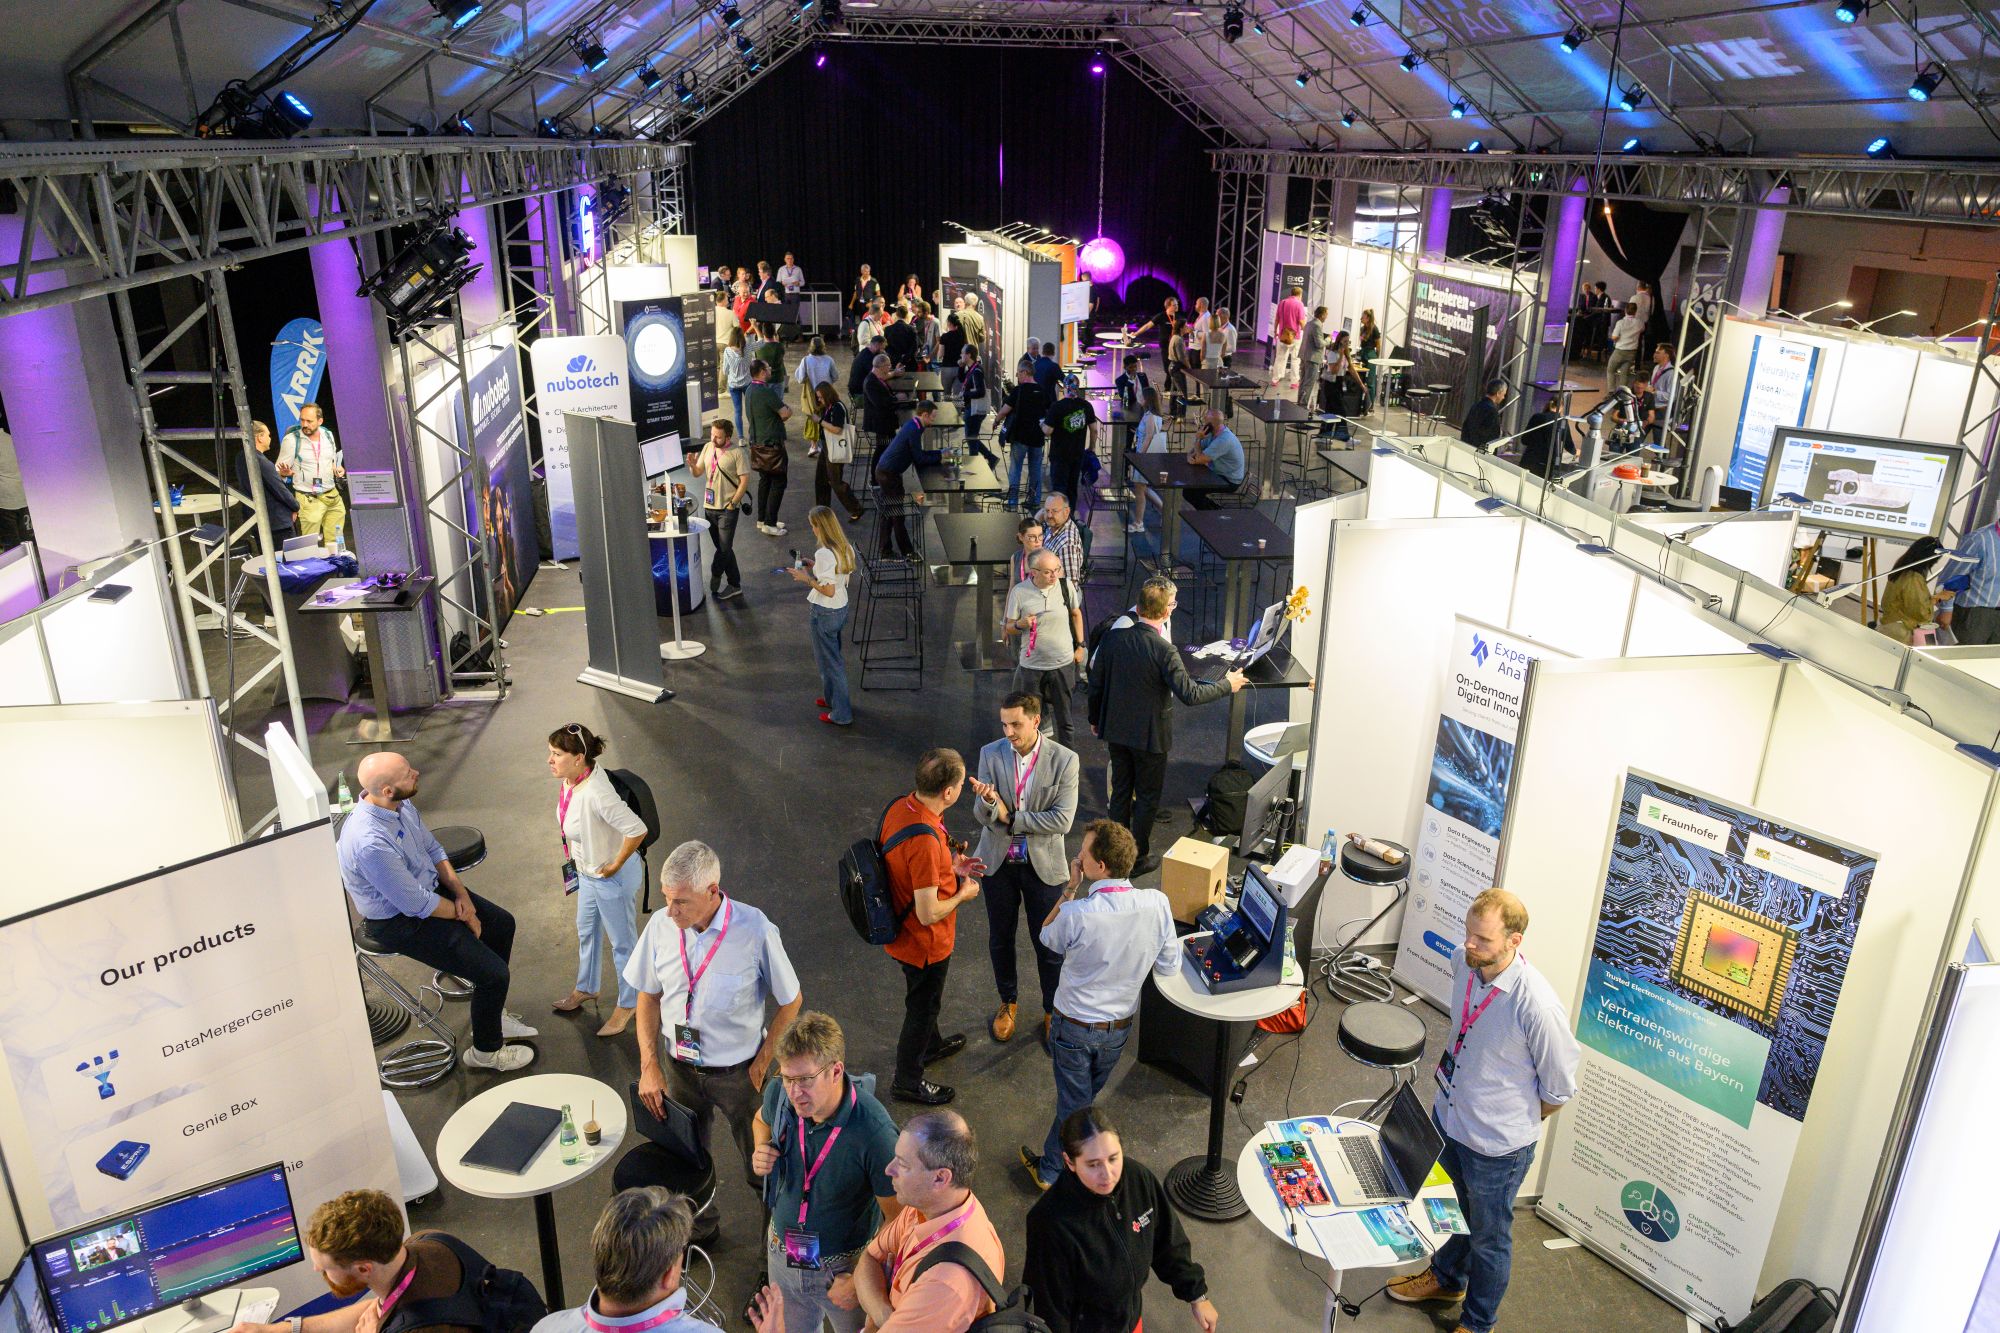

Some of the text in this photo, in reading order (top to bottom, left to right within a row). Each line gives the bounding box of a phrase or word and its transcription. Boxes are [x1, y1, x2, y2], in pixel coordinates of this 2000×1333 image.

[1428, 284, 1468, 310] kapieren
[1414, 304, 1437, 323] statt
[281, 330, 324, 421] ARRK
[547, 372, 619, 392] nubotech
[1759, 362, 1800, 382] Neuralyze
[482, 366, 510, 417] nubotech
[1756, 381, 1774, 394] Vision
[576, 403, 618, 412] Architecture
[1456, 673, 1519, 706] On-Demand
[1457, 686, 1490, 708] Digital
[1447, 826, 1460, 836] Data
[1461, 833, 1490, 853] Engineering
[1662, 814, 1718, 842] Fraunhofer
[1443, 851, 1456, 862] Data
[1456, 858, 1475, 873] Science
[1440, 878, 1460, 894] Systems
[1433, 903, 1456, 920] Software
[100, 922, 256, 986] Our products
[1406, 946, 1419, 959] From
[1419, 954, 1442, 973] Industrial
[1605, 970, 1718, 1028] Trusted Electronic Bayern Center
[162, 997, 294, 1058] DataMergerGenie
[1600, 996, 1731, 1068] Vertrauenswürdige
[1597, 1011, 1744, 1092] Elektronik aus Bayern
[182, 1098, 258, 1137] Genie Box
[120, 1144, 146, 1170] ESPRIT
[1564, 1208, 1593, 1229] Fraunhofer
[1627, 1248, 1657, 1272] Fraunhofer
[1694, 1291, 1726, 1316] Fraunhofer
